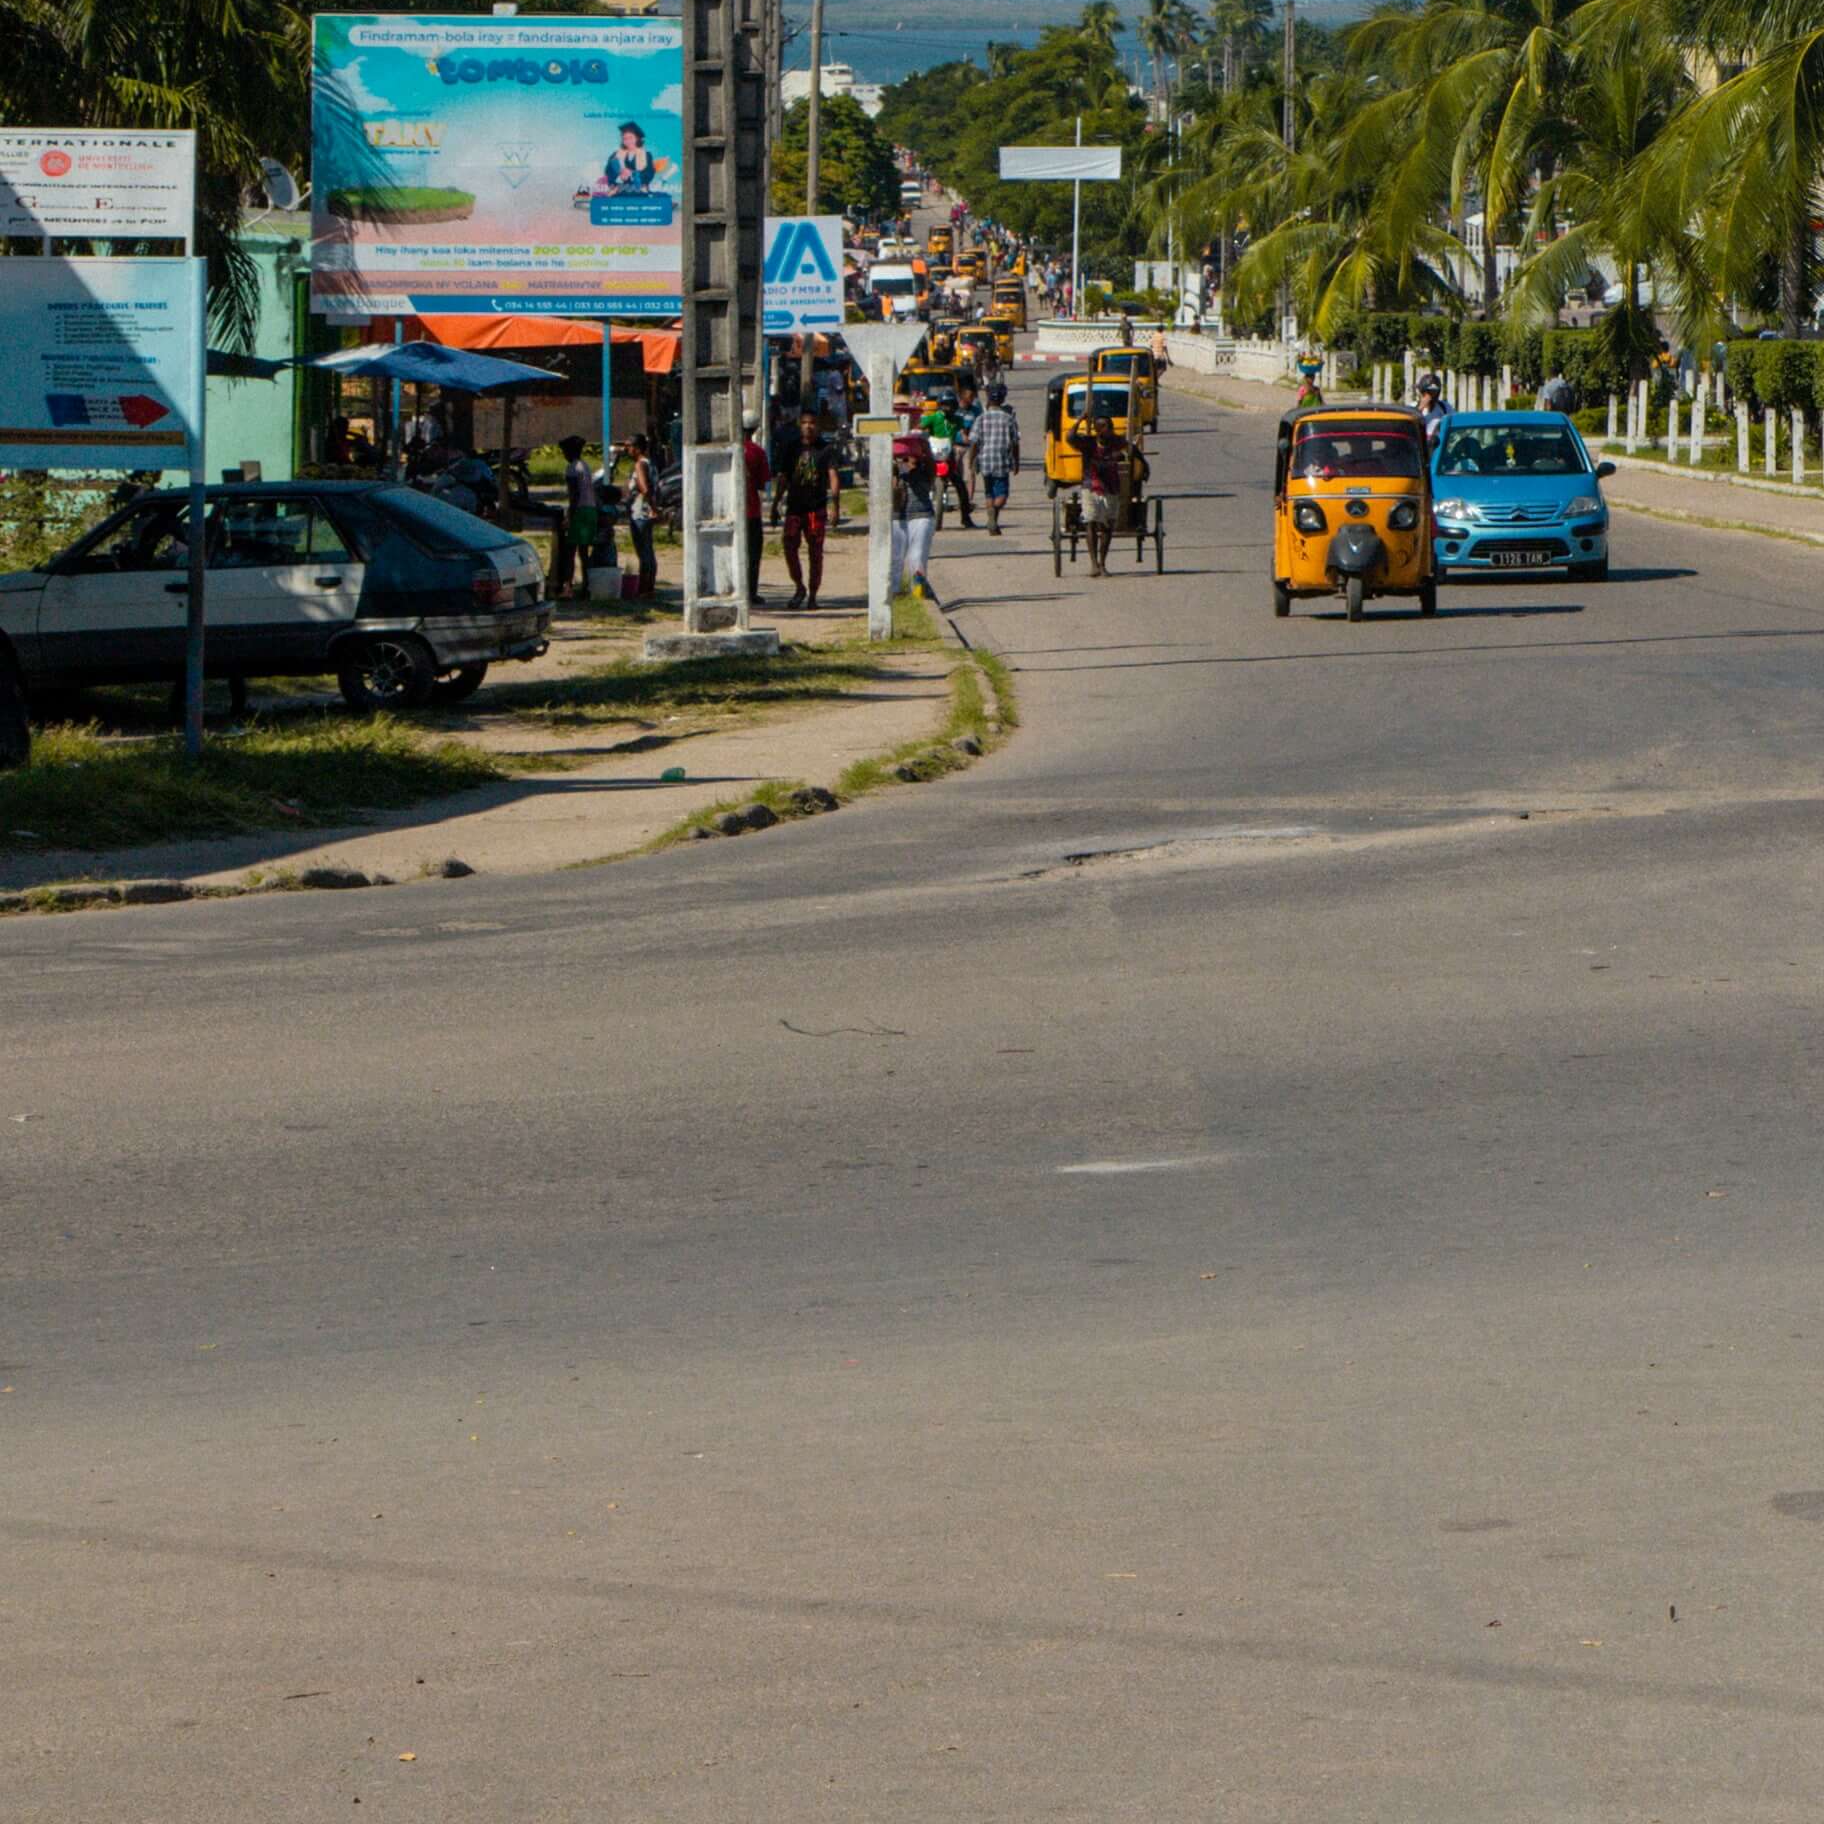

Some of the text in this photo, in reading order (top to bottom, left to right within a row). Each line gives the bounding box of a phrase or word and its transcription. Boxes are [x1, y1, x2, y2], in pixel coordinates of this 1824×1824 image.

[359, 31, 476, 42] Findramam-bola
[478, 31, 503, 44] iray
[518, 32, 599, 43] fandraisana
[603, 33, 645, 45] anjara
[648, 33, 673, 45] iray
[479, 246, 530, 255] mitentina
[533, 246, 560, 255] 200
[565, 246, 595, 255] 000
